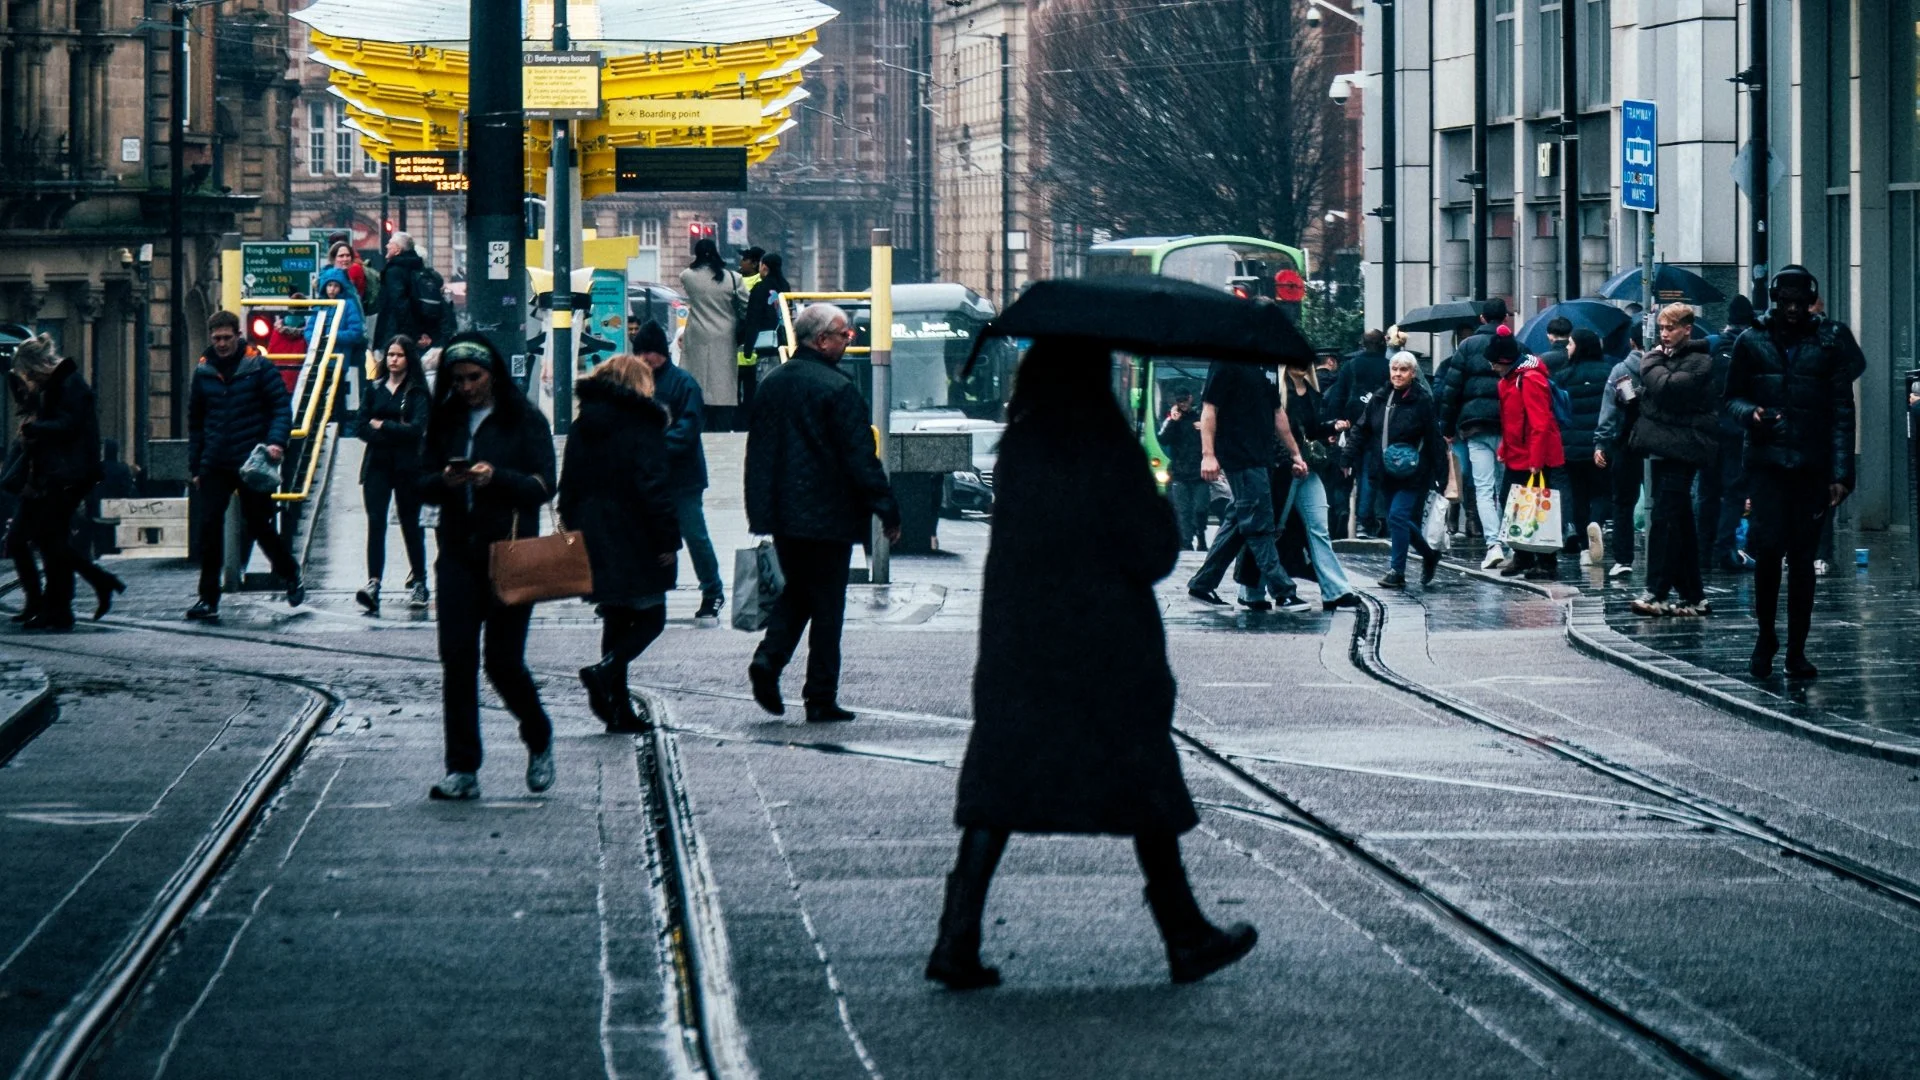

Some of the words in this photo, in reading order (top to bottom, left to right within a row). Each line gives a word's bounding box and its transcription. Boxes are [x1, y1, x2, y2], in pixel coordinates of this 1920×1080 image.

[534, 54, 556, 62] Before
[571, 54, 591, 62] board
[639, 109, 676, 119] Boarding
[678, 110, 700, 119] point
[1626, 107, 1652, 120] TRAMWAY
[395, 157, 411, 165] East
[412, 157, 444, 166] Didsbury
[395, 165, 411, 173] East
[412, 165, 444, 174] Didsbury
[423, 173, 448, 182] Square
[1631, 188, 1646, 201] WAYS
[246, 247, 263, 255] Ring
[246, 266, 282, 274] Liverpool
